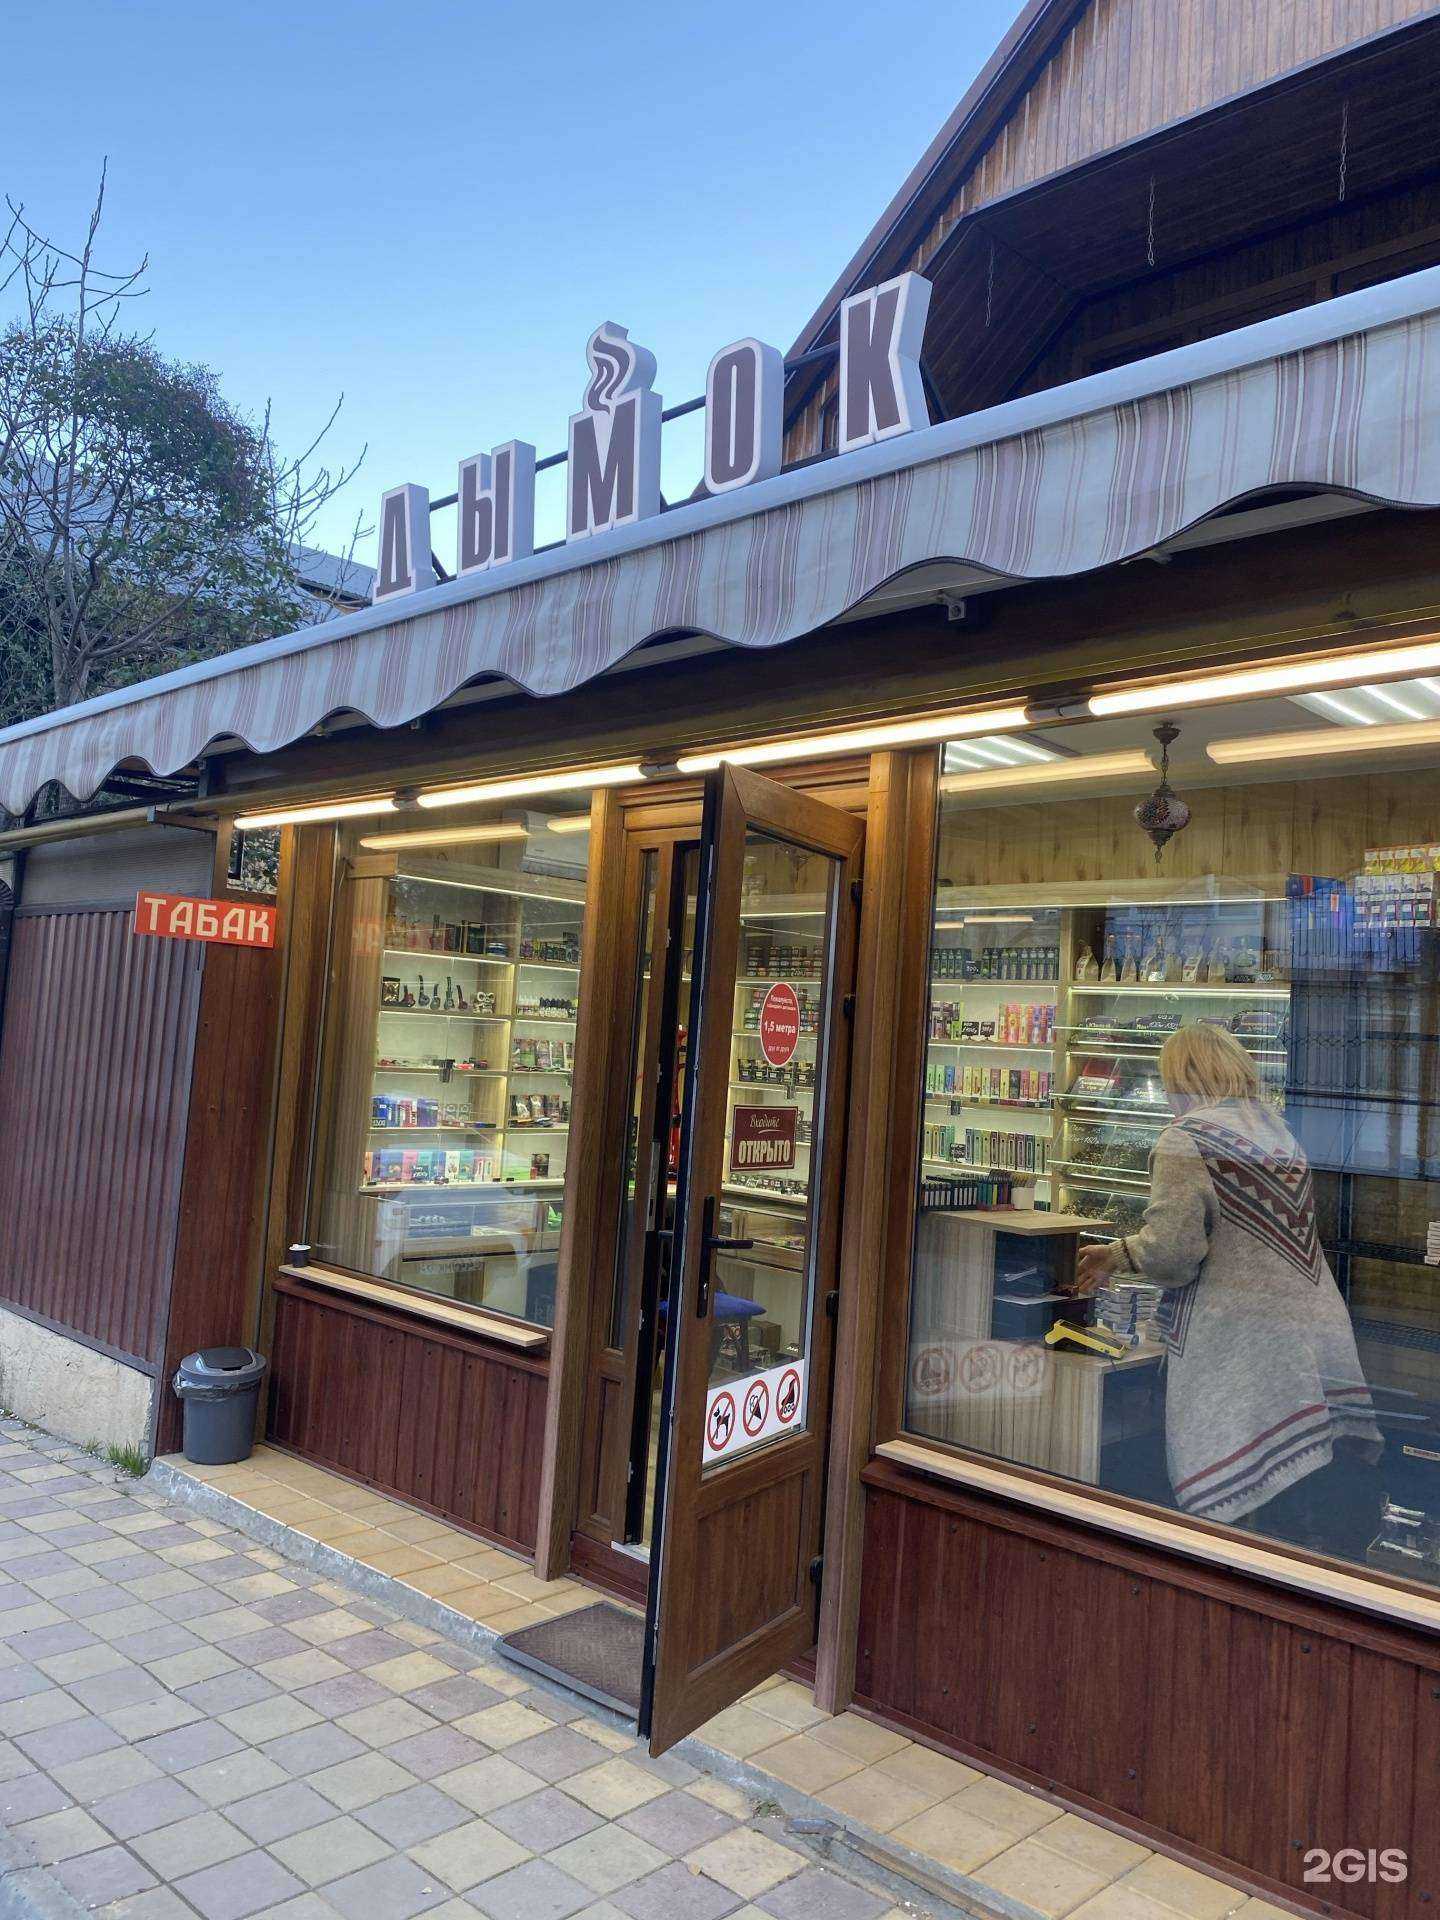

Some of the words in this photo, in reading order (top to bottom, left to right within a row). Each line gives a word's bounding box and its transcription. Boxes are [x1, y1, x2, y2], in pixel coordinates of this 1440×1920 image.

[372, 271, 931, 604] ДЫМОК
[144, 897, 270, 943] ТАБАК
[764, 1020, 775, 1034] 1,5
[775, 1024, 796, 1036] метра
[750, 1114, 780, 1128] Входите
[738, 1140, 791, 1164] ОТКРЫТО
